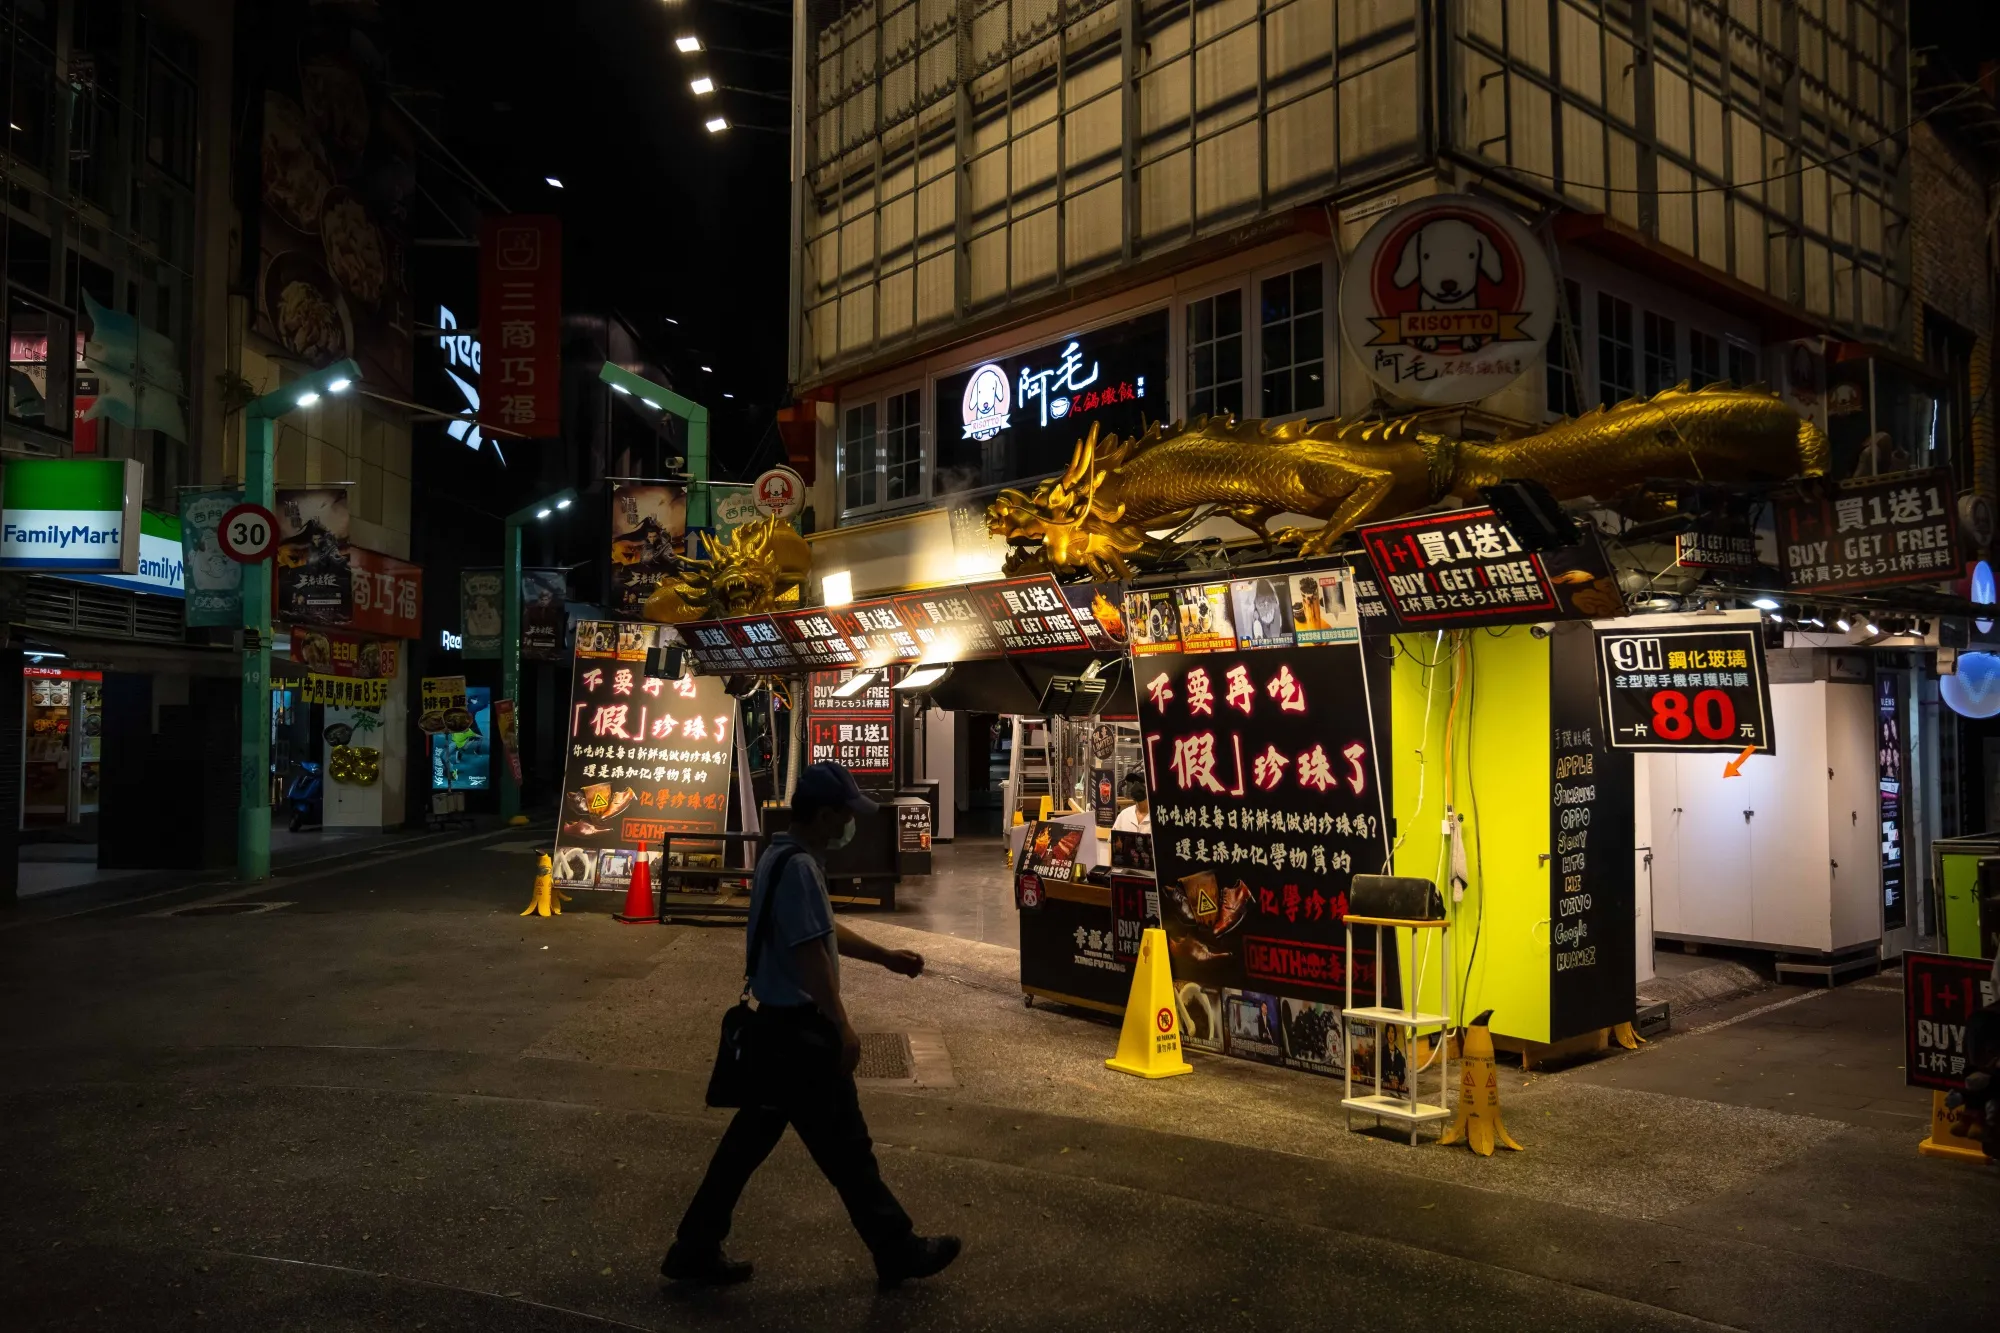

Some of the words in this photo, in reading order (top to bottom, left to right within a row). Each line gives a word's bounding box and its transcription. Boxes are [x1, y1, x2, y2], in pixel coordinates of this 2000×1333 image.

[1408, 313, 1493, 332] RISOTTO
[499, 282, 537, 425] 三商巧福
[1374, 349, 1438, 383] 阿毛
[1019, 341, 1099, 428] 阿毛
[4, 524, 119, 549] FamilyMart
[232, 522, 265, 546] 30
[1680, 532, 1699, 548] BUY
[1707, 536, 1724, 551] GET
[1731, 538, 1752, 552] FREE
[1787, 541, 1829, 569] BUY
[1843, 535, 1883, 561] GET
[1896, 525, 1949, 553] FREE
[1388, 573, 1428, 597] BUY
[1439, 568, 1477, 591] GET
[1485, 561, 1537, 586] FREE
[1790, 549, 1951, 584] 1杯買うともう1杯無料
[1400, 583, 1544, 615] 1杯買うともう1杯無料
[994, 620, 1017, 637] BUY
[1021, 617, 1043, 635] GET
[1046, 613, 1076, 632] FREE
[440, 629, 463, 651] Ree
[741, 645, 757, 661] BUY
[760, 643, 773, 660] GET
[773, 641, 791, 657] FREE
[792, 642, 811, 658] BUY
[810, 639, 828, 655] GET
[829, 635, 850, 651] FREE
[850, 634, 870, 653] BUY
[893, 629, 915, 646] FREE
[1003, 629, 1083, 655] 1杯買うともう1杯無料
[1610, 639, 1664, 673] 9H
[1667, 648, 1748, 671] 鋼化玻璃
[813, 686, 835, 699] BUY
[866, 685, 890, 699] FREE
[1146, 664, 1307, 715] 不要再吃
[1614, 672, 1749, 689] 全型號手機保護貼膜
[813, 698, 890, 709] 1杯買うともう1杯無料
[1619, 723, 1649, 738] 一片
[1651, 689, 1736, 741] 80
[1740, 723, 1756, 738] 元
[813, 745, 835, 758] BUY
[841, 745, 860, 758] GET
[866, 745, 890, 758] FREE
[1146, 732, 1367, 796] 「假」珍珠了
[1555, 753, 1594, 779] APPLE
[1560, 806, 1591, 831] OPPO
[1562, 851, 1586, 874] HTC
[1560, 893, 1592, 917] VIVO
[1117, 918, 1141, 941] BUY
[1555, 919, 1588, 947] Google
[1918, 1018, 1966, 1054] BUY
